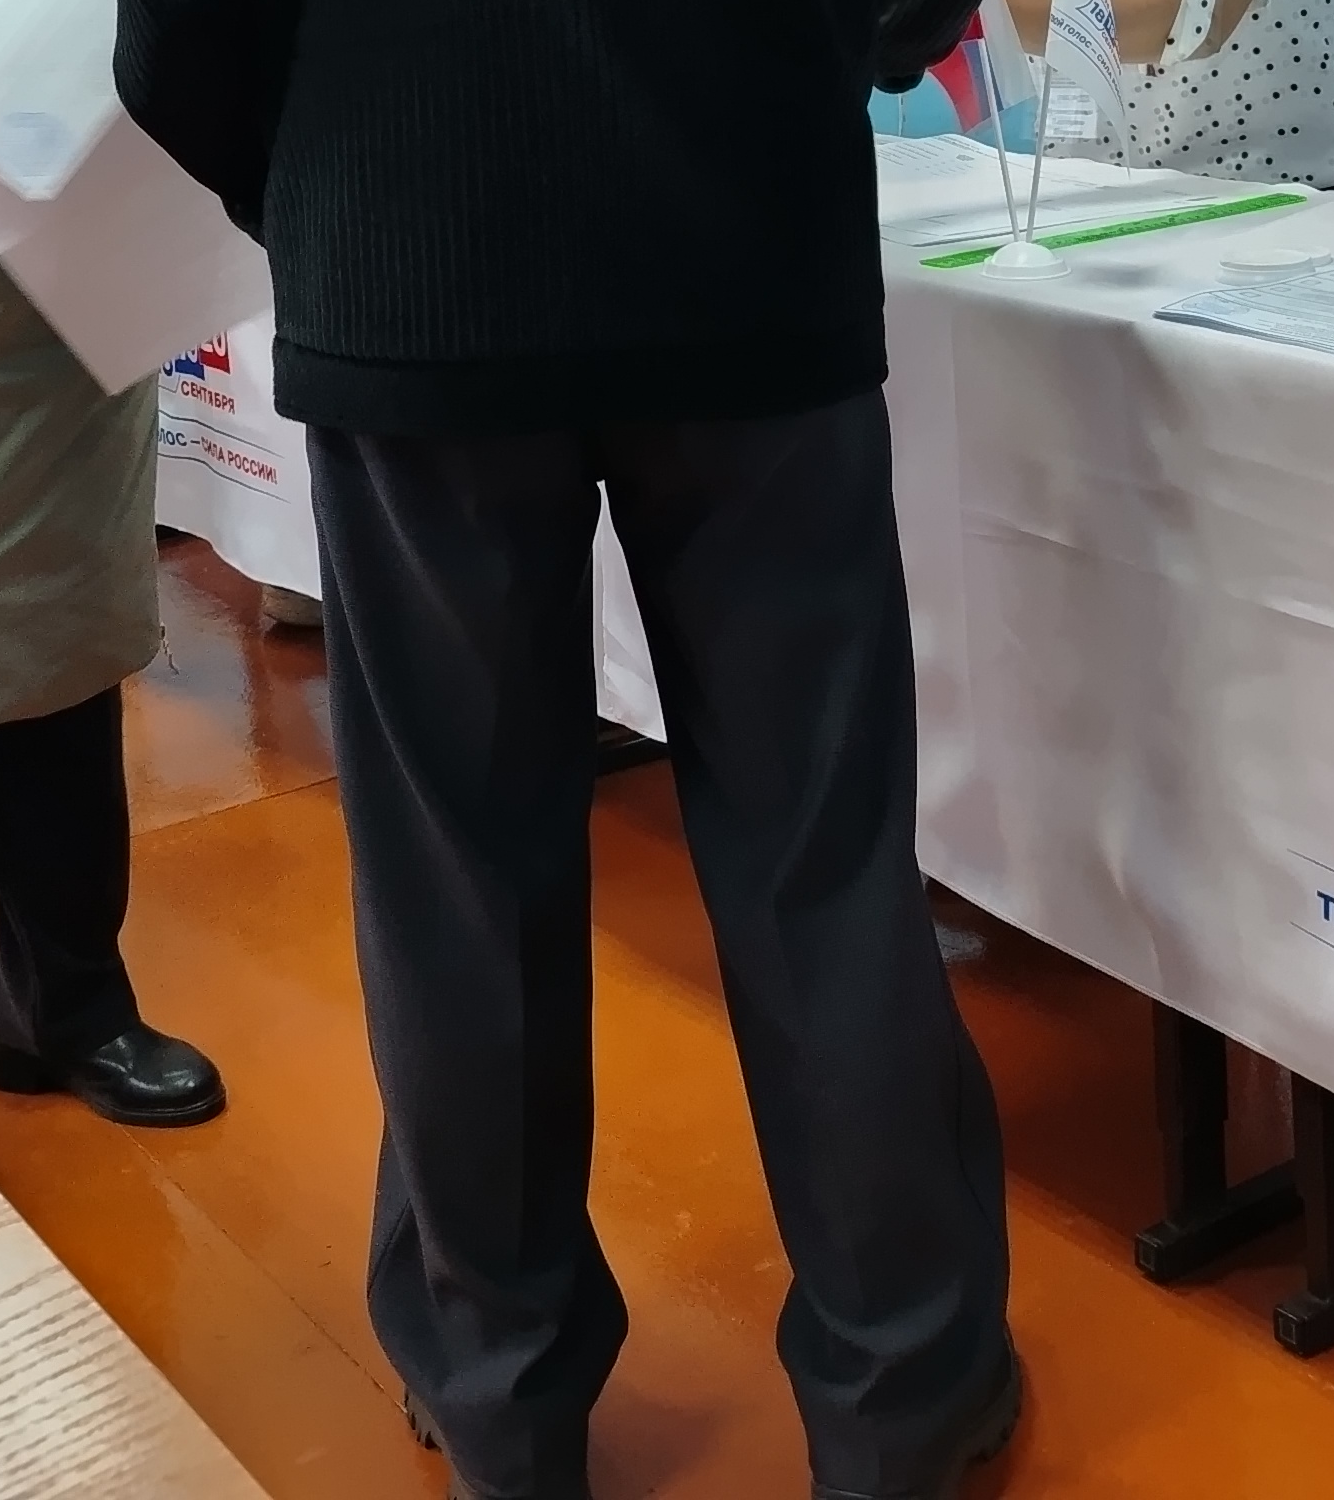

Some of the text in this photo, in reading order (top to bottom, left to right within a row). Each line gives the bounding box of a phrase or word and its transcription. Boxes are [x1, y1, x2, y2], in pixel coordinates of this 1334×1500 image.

[1090, 2, 1105, 24] 18
[1051, 14, 1064, 31] ВОЙ
[1063, 23, 1092, 49] ГОЛОС
[181, 380, 235, 415] СЕНТЯБРЯ
[158, 428, 187, 446] ЛОС
[201, 436, 225, 463] СИЛА
[228, 450, 278, 485] РОССИИ!
